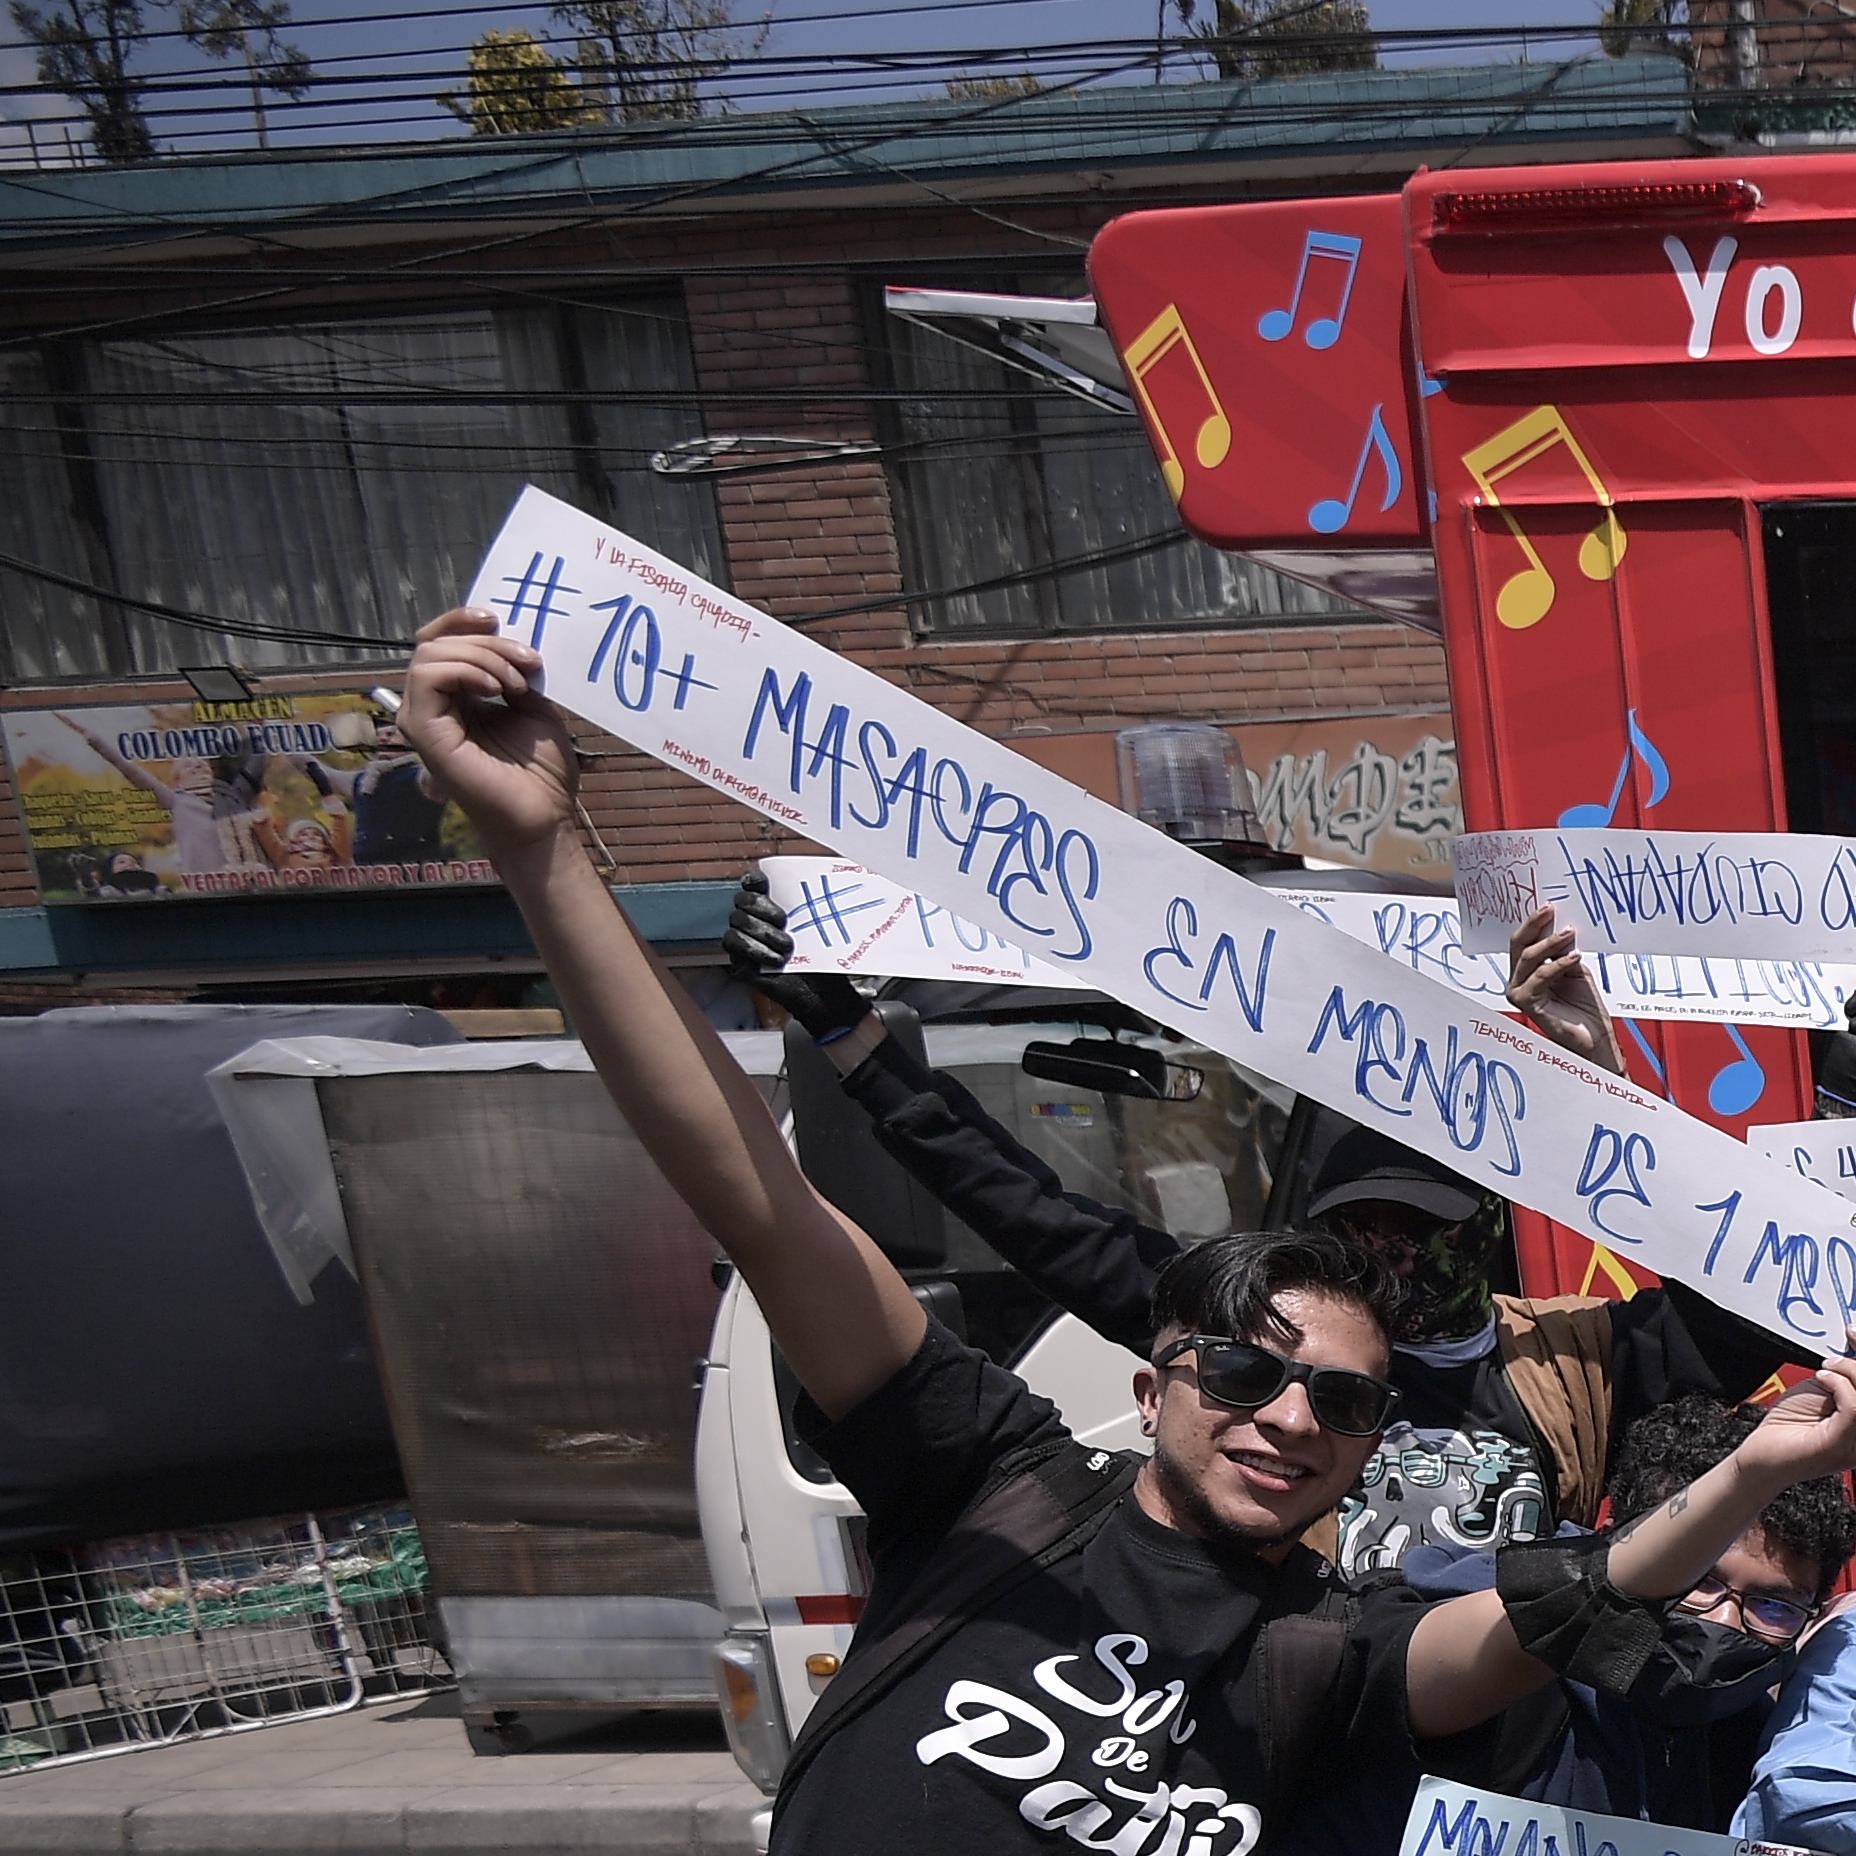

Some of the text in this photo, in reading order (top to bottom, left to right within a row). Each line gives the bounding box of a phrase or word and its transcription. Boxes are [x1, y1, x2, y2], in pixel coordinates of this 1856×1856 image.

[1664, 234, 1803, 358] Yo
[118, 720, 331, 760] COLOMBO ECUAD
[257, 869, 279, 889] AL
[283, 868, 323, 889] POR
[329, 865, 403, 888] MAYOR
[423, 862, 445, 883] AL
[742, 664, 1101, 962] MASACRES
[1145, 894, 1279, 1035] EN
[1306, 984, 1528, 1178] MENOS
[1575, 1121, 1657, 1246] DE
[1092, 1736, 1151, 1773] De
